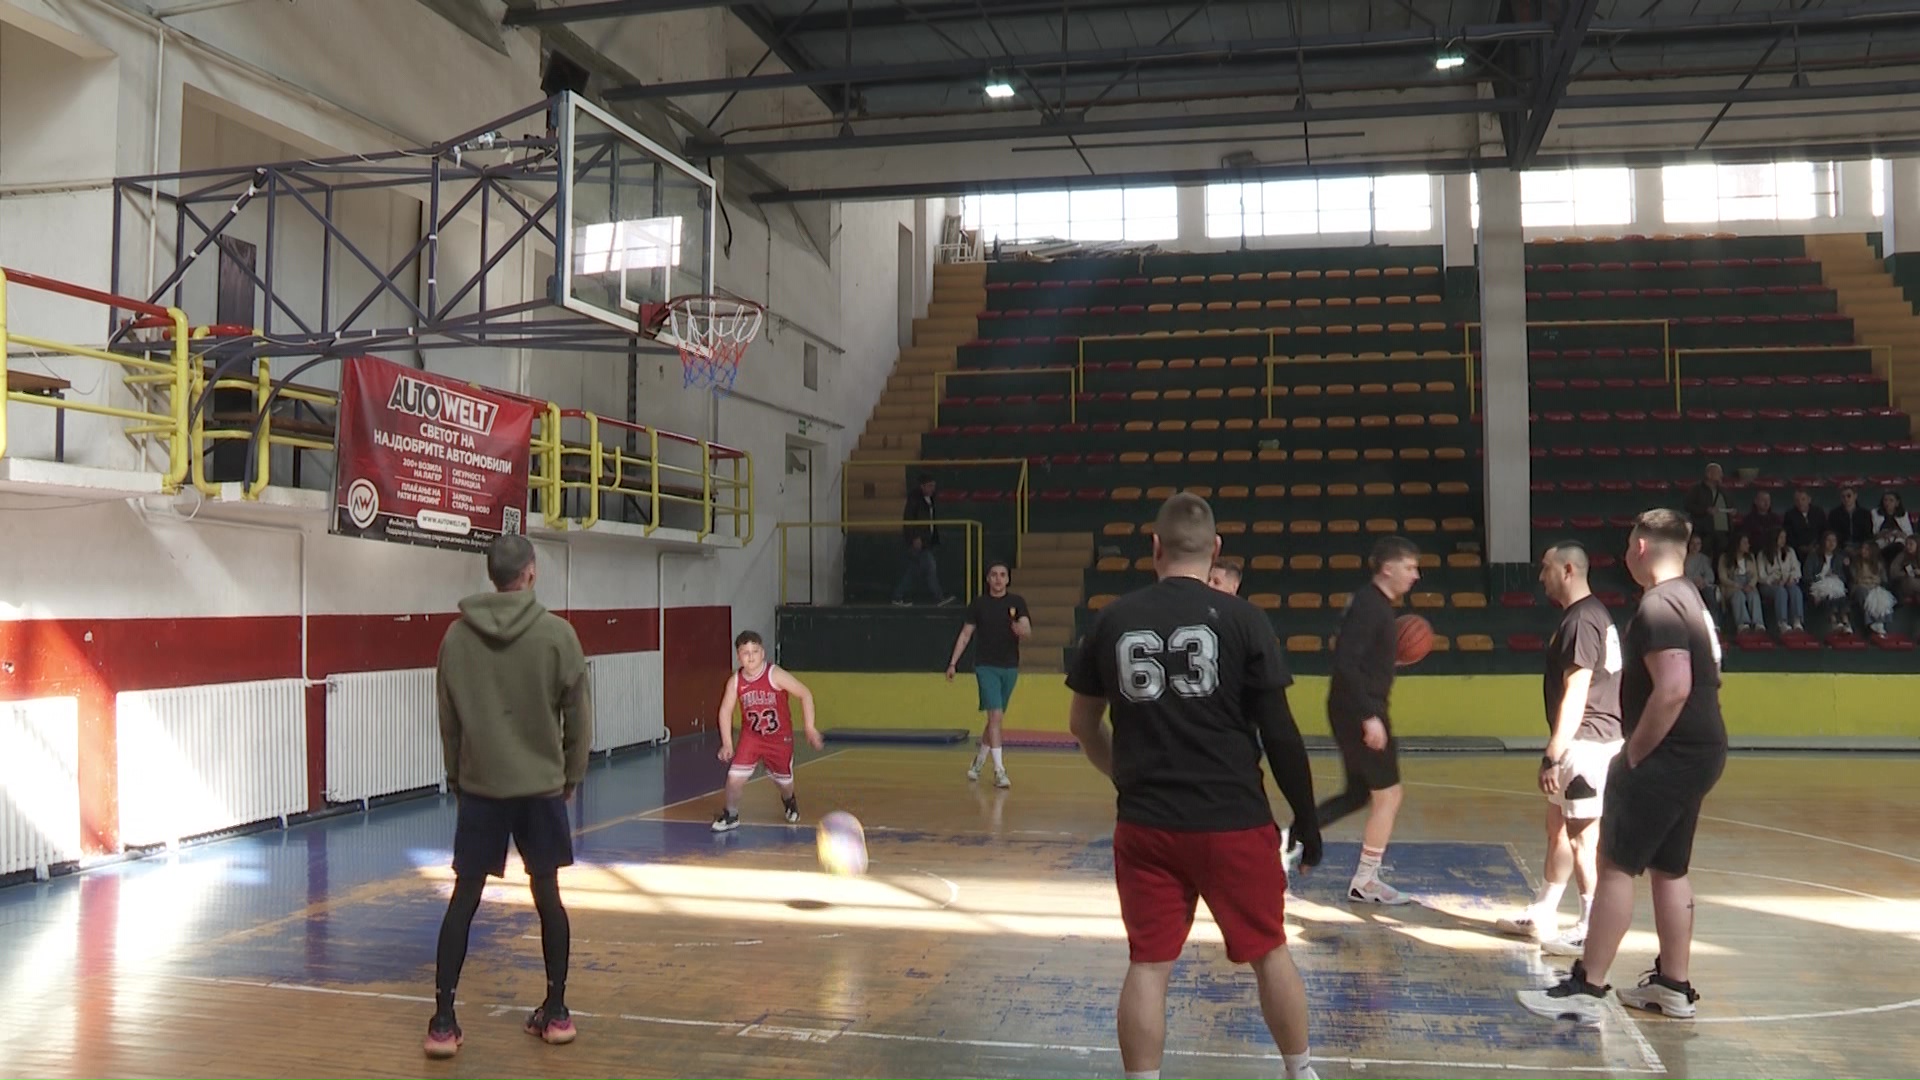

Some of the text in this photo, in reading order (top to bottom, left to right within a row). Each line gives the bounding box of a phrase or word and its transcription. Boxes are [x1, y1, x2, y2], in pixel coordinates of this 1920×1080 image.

[374, 429, 512, 475] НАЈДОБРИТЕ АВТОМОБИЛИ
[420, 423, 475, 449] СВЕТОТ НА
[1115, 624, 1219, 702] 63
[747, 708, 780, 736] 23
